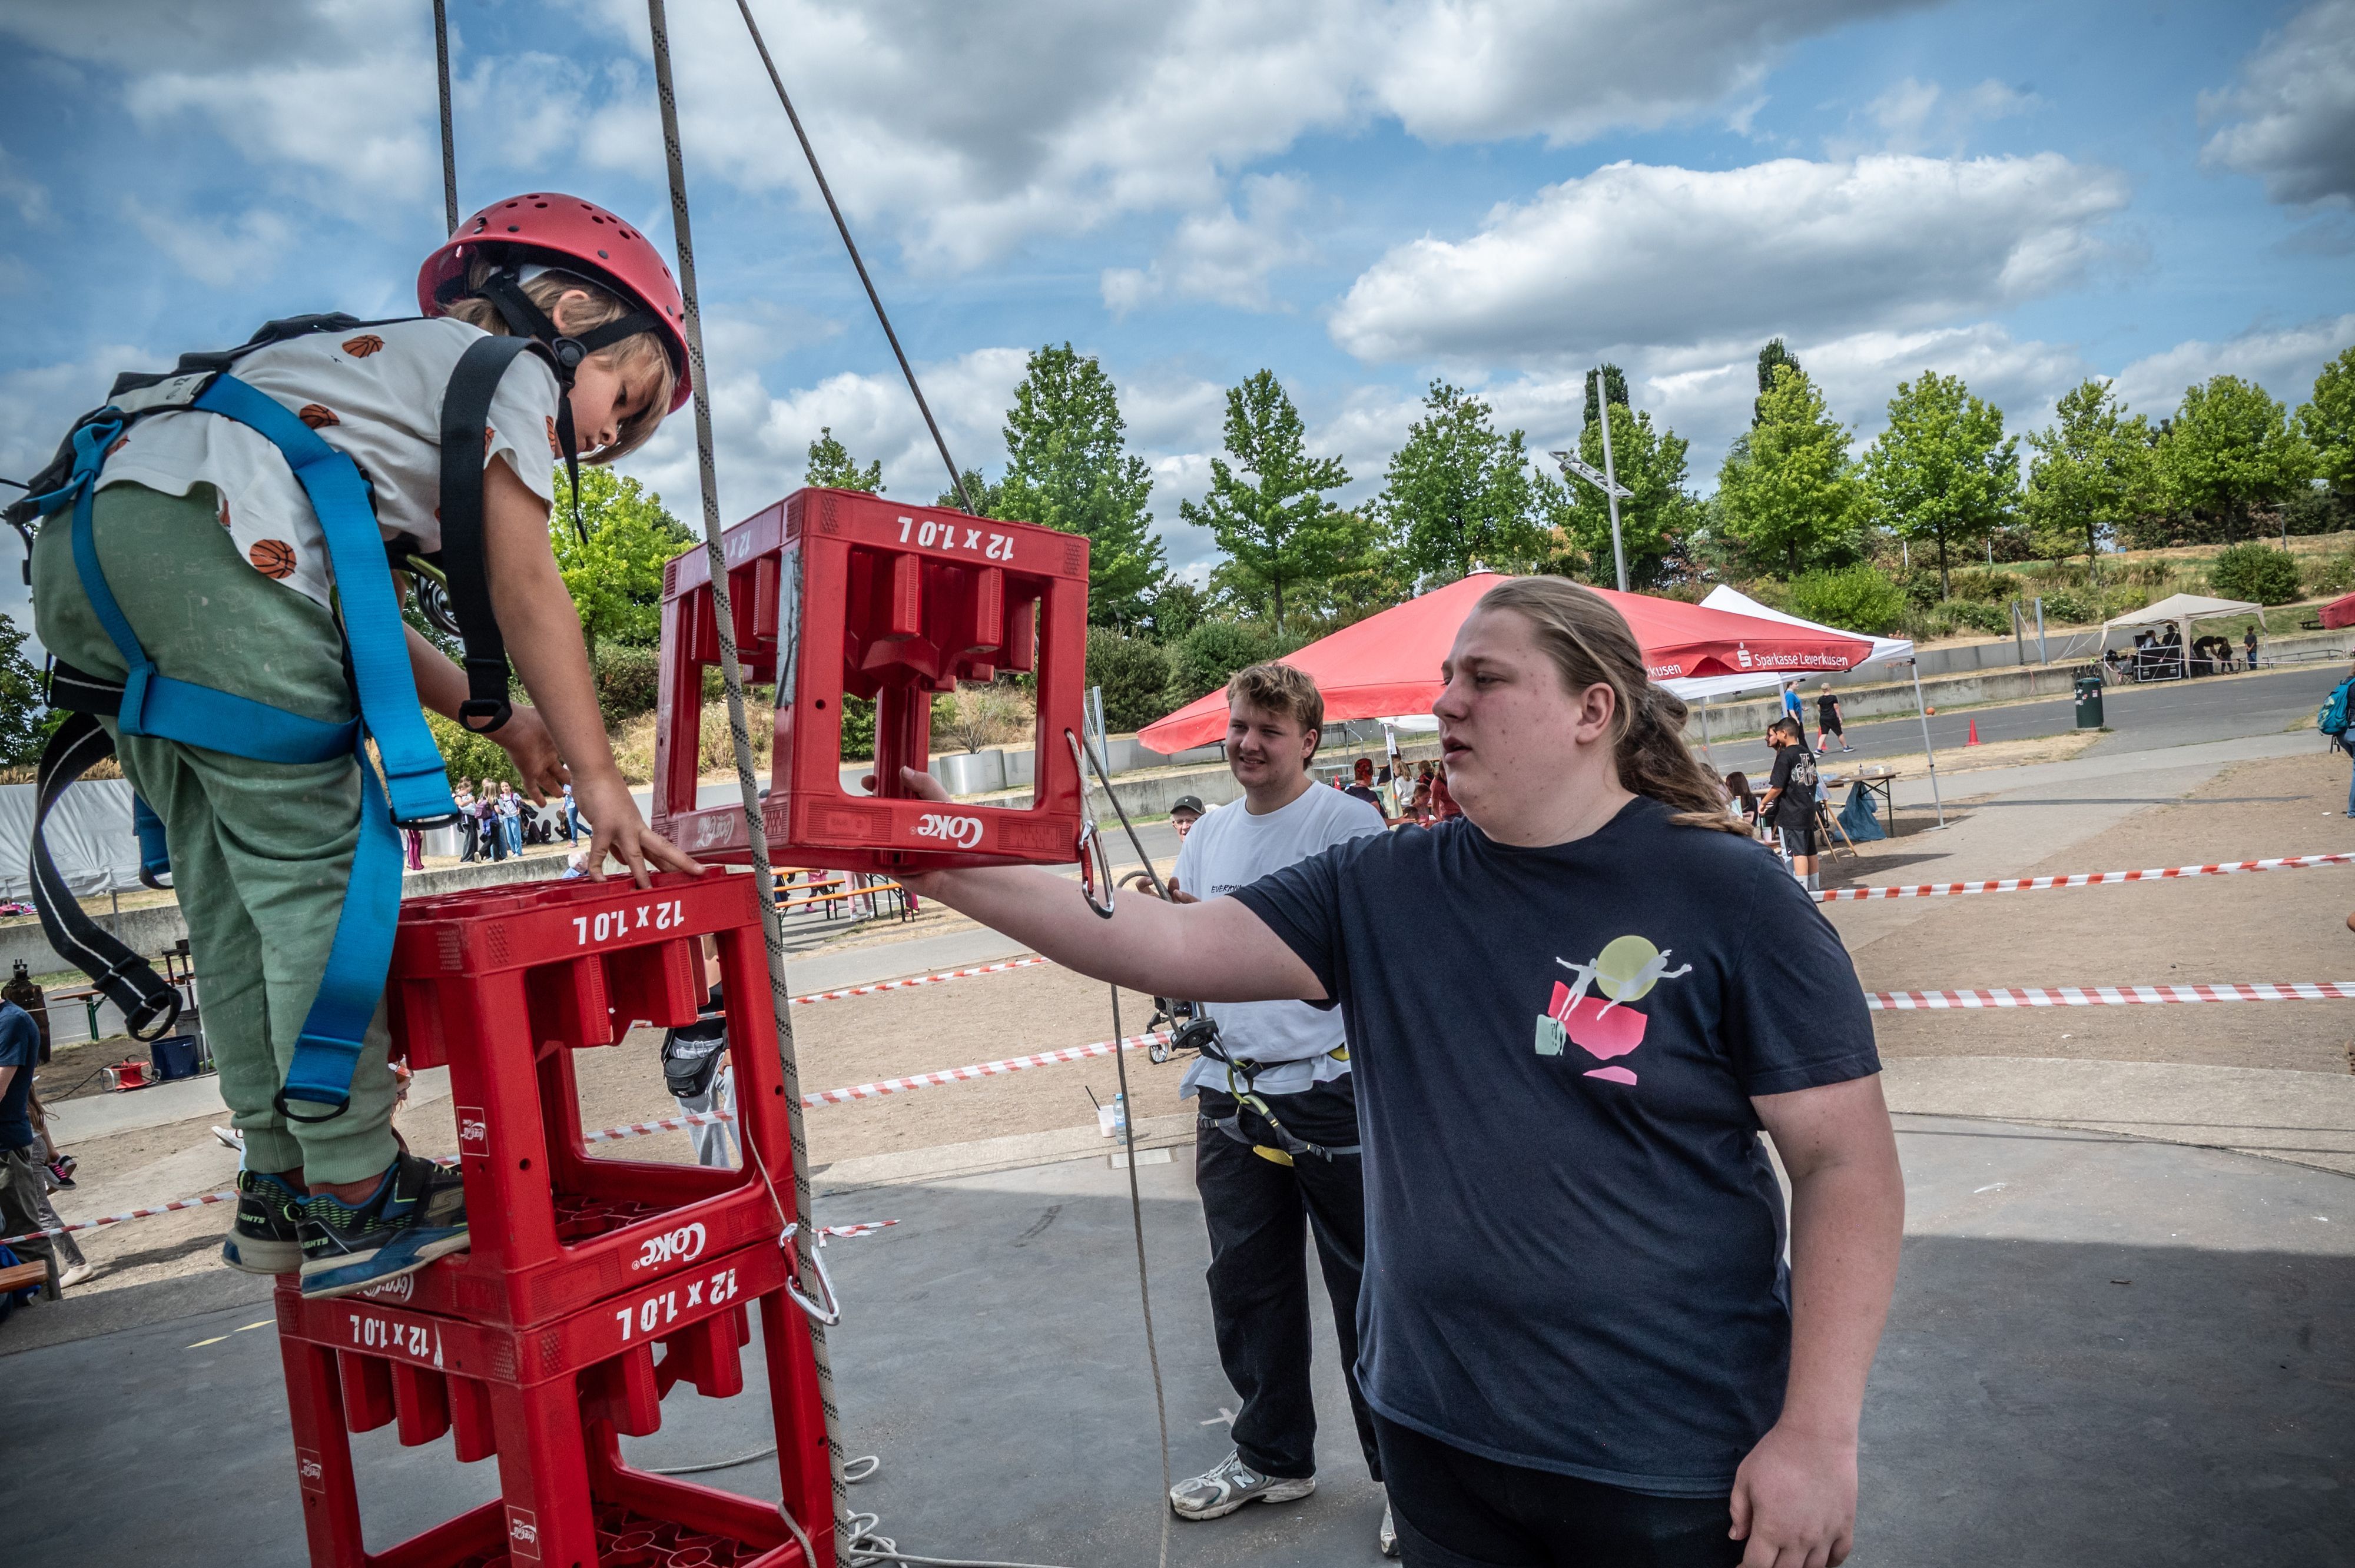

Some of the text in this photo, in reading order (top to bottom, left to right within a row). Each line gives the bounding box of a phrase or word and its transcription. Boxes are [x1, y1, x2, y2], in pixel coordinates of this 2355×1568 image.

[963, 529, 982, 550] x
[985, 533, 1014, 561] 12
[1646, 664, 1682, 677] rkusen
[1754, 652, 1848, 669] Sparkasse Leverkusen
[1210, 884, 1242, 893] EVERYON
[635, 905, 650, 928] x
[656, 900, 685, 930] 12
[686, 1280, 704, 1308] x
[709, 1268, 738, 1305] 12
[393, 1323, 404, 1346] x
[409, 1326, 429, 1357] 12
